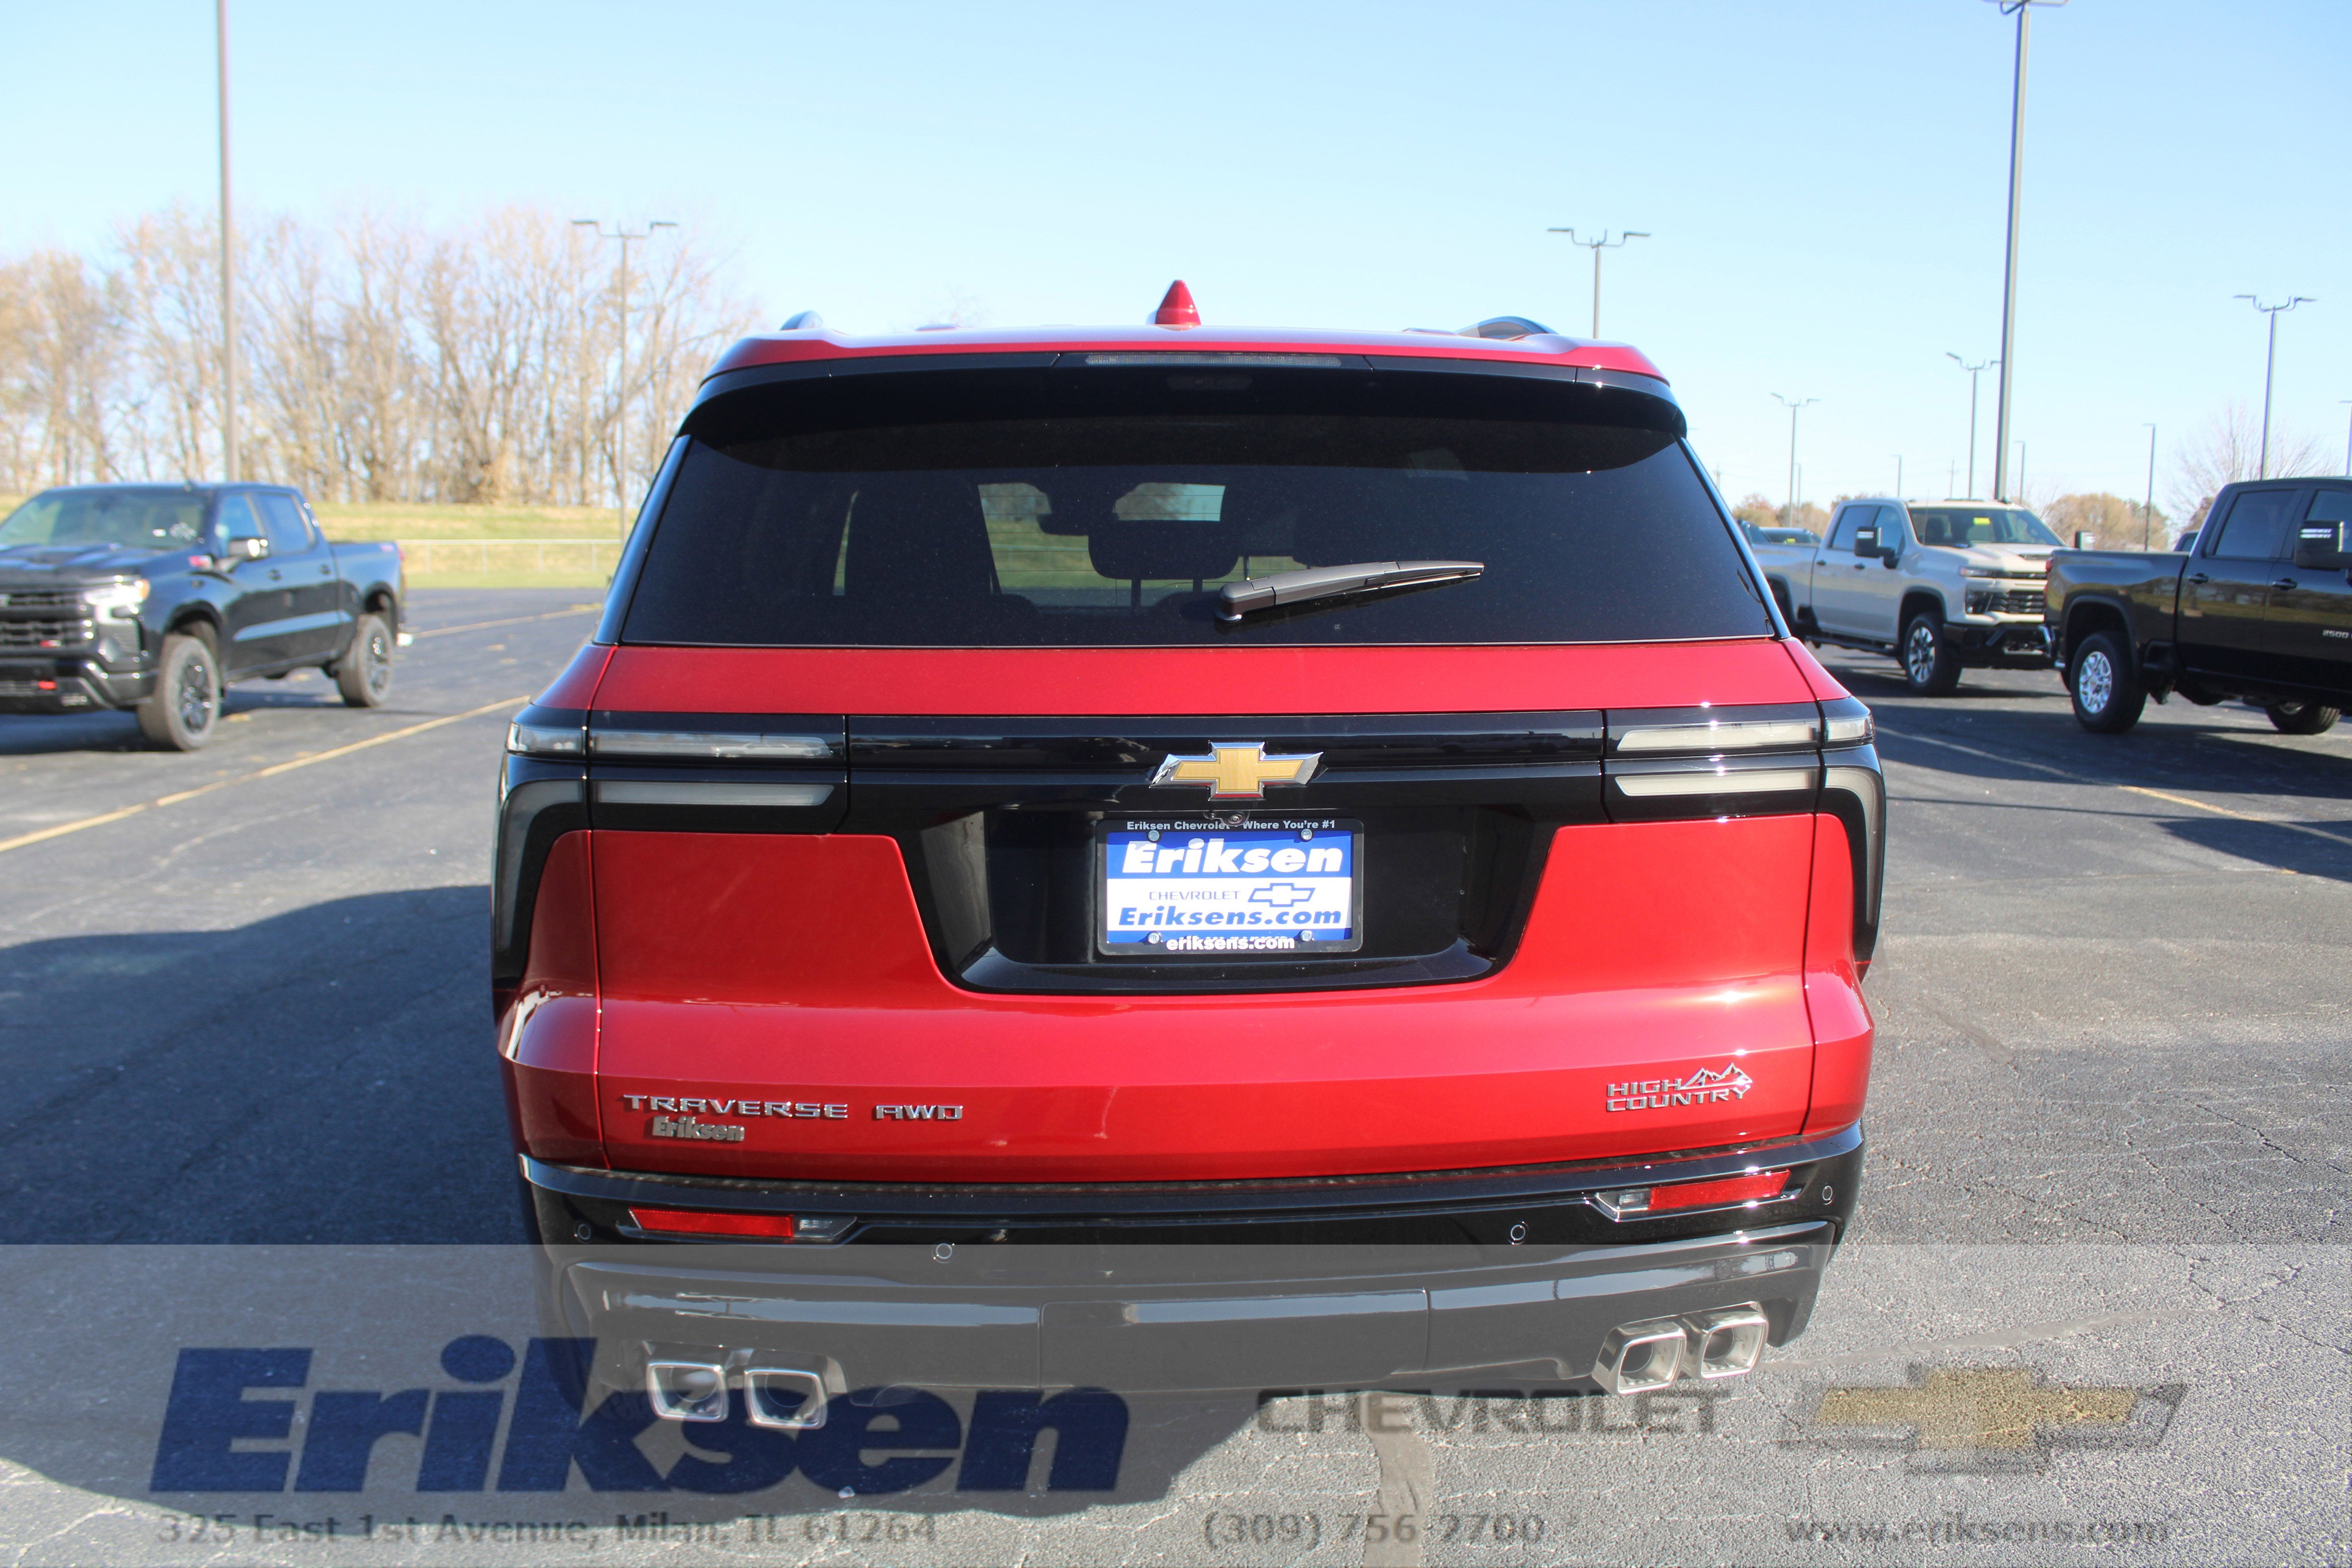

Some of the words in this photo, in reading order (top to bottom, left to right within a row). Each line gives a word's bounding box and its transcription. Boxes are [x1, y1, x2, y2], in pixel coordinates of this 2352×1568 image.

[1127, 821, 1171, 830] Eriksen
[1174, 821, 1230, 830] Chevrolet
[1242, 821, 1279, 829] Where
[1283, 820, 1319, 829] You're
[1322, 820, 1335, 829] #1
[1122, 838, 1343, 873] Eriksen
[1149, 891, 1241, 901] CHEVROLET
[1118, 905, 1341, 926] Eriksens.com
[1166, 935, 1295, 951] eriksens.com
[1607, 1078, 1682, 1096] HIGH
[623, 1094, 849, 1119] TRAVERSE
[876, 1104, 963, 1120] AWD
[1606, 1085, 1751, 1111] COUNTRY
[651, 1115, 745, 1142] Eriksen
